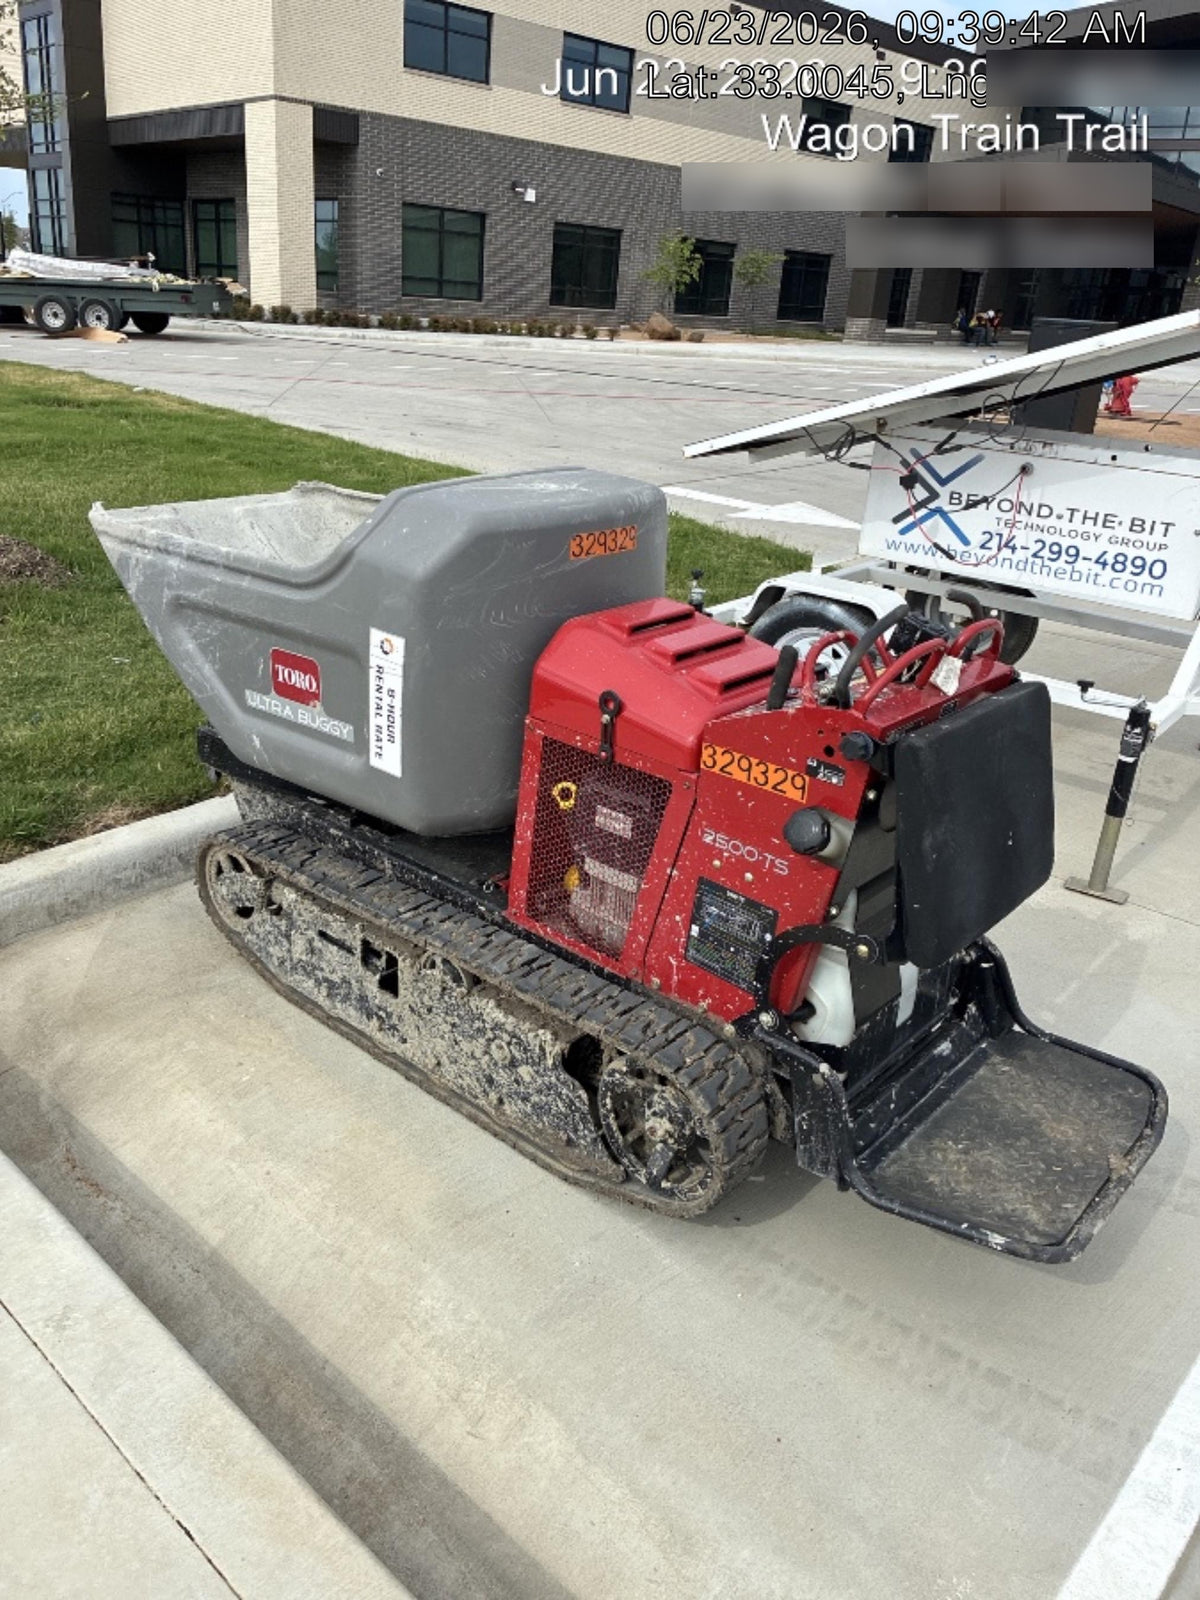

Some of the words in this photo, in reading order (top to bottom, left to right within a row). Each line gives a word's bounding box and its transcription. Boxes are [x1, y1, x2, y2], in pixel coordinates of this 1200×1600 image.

[995, 517, 1103, 543] TECHNOLOGY
[1108, 534, 1169, 552] GROUP
[1129, 516, 1176, 538] BIT
[979, 530, 1168, 581] 214-299-4890
[246, 691, 294, 720] ULTRA
[297, 707, 351, 739] BUGGY
[374, 664, 385, 718] RENTAL
[374, 724, 384, 759] RATE
[702, 744, 807, 800] 329329
